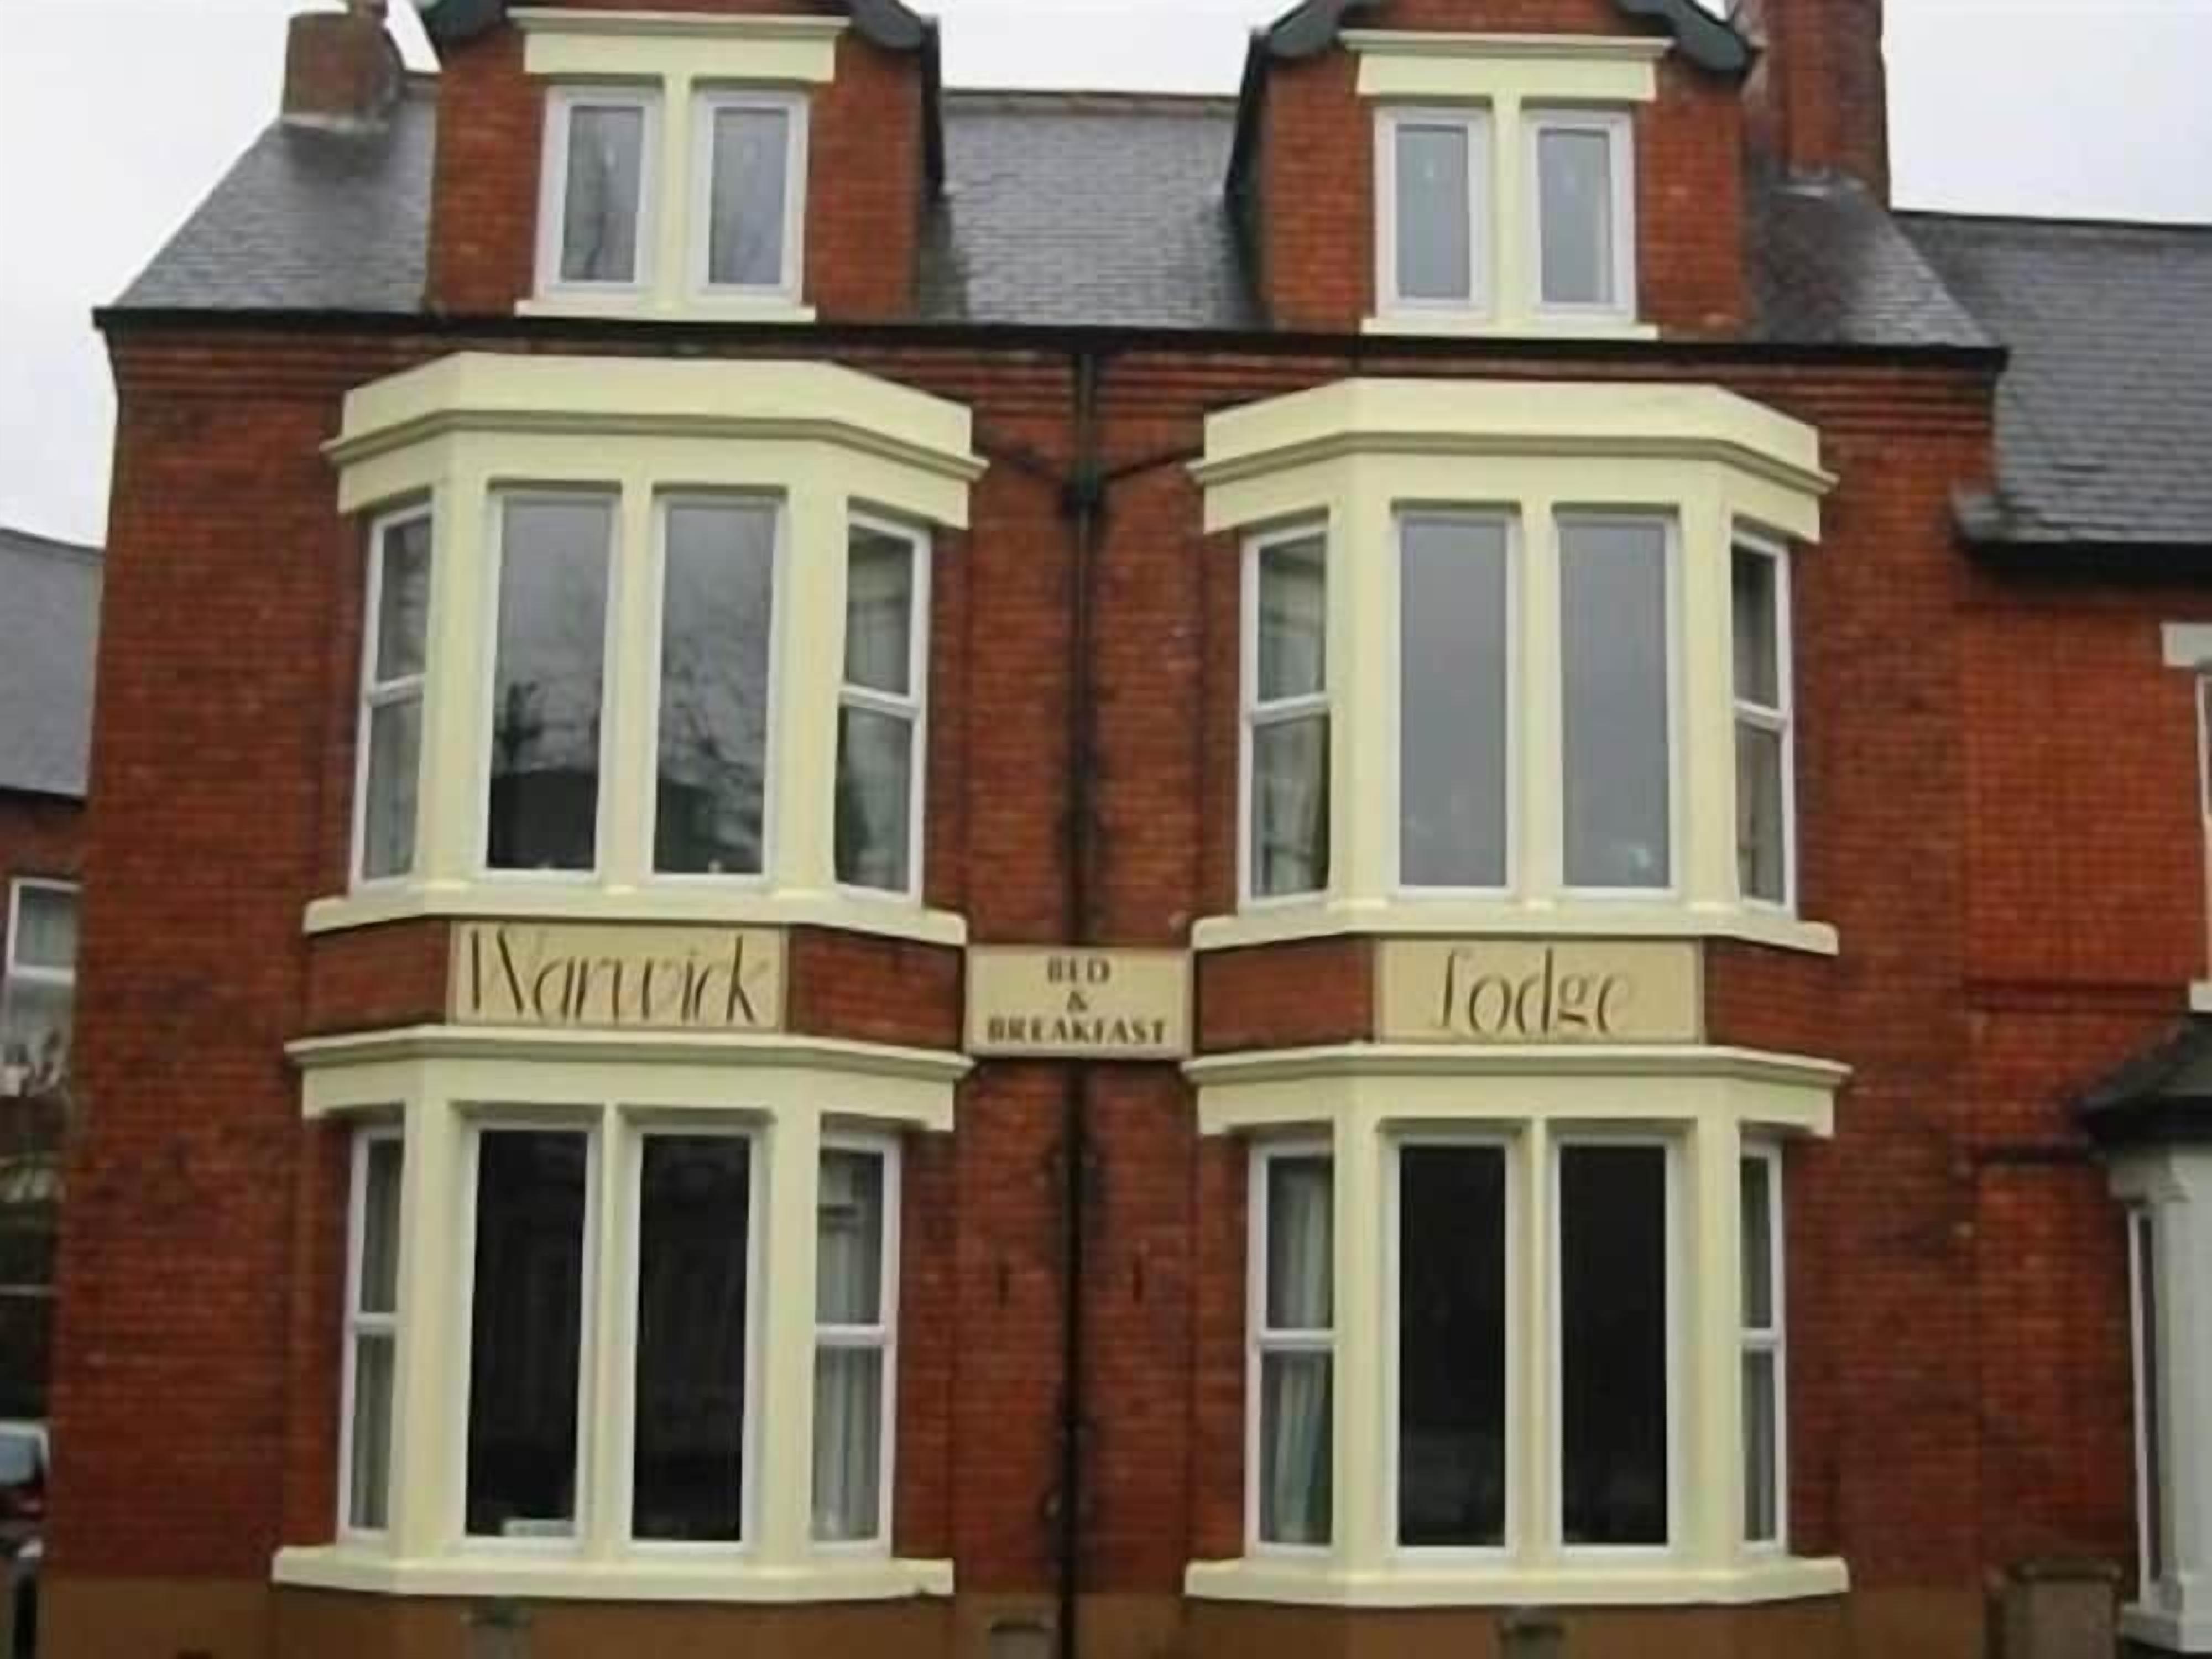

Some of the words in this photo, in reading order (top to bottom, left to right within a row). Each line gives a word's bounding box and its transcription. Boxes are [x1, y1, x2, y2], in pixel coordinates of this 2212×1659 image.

[469, 929, 769, 1023] Warwick
[1047, 956, 1110, 983] BED
[987, 1016, 1165, 1044] BREAKFAST
